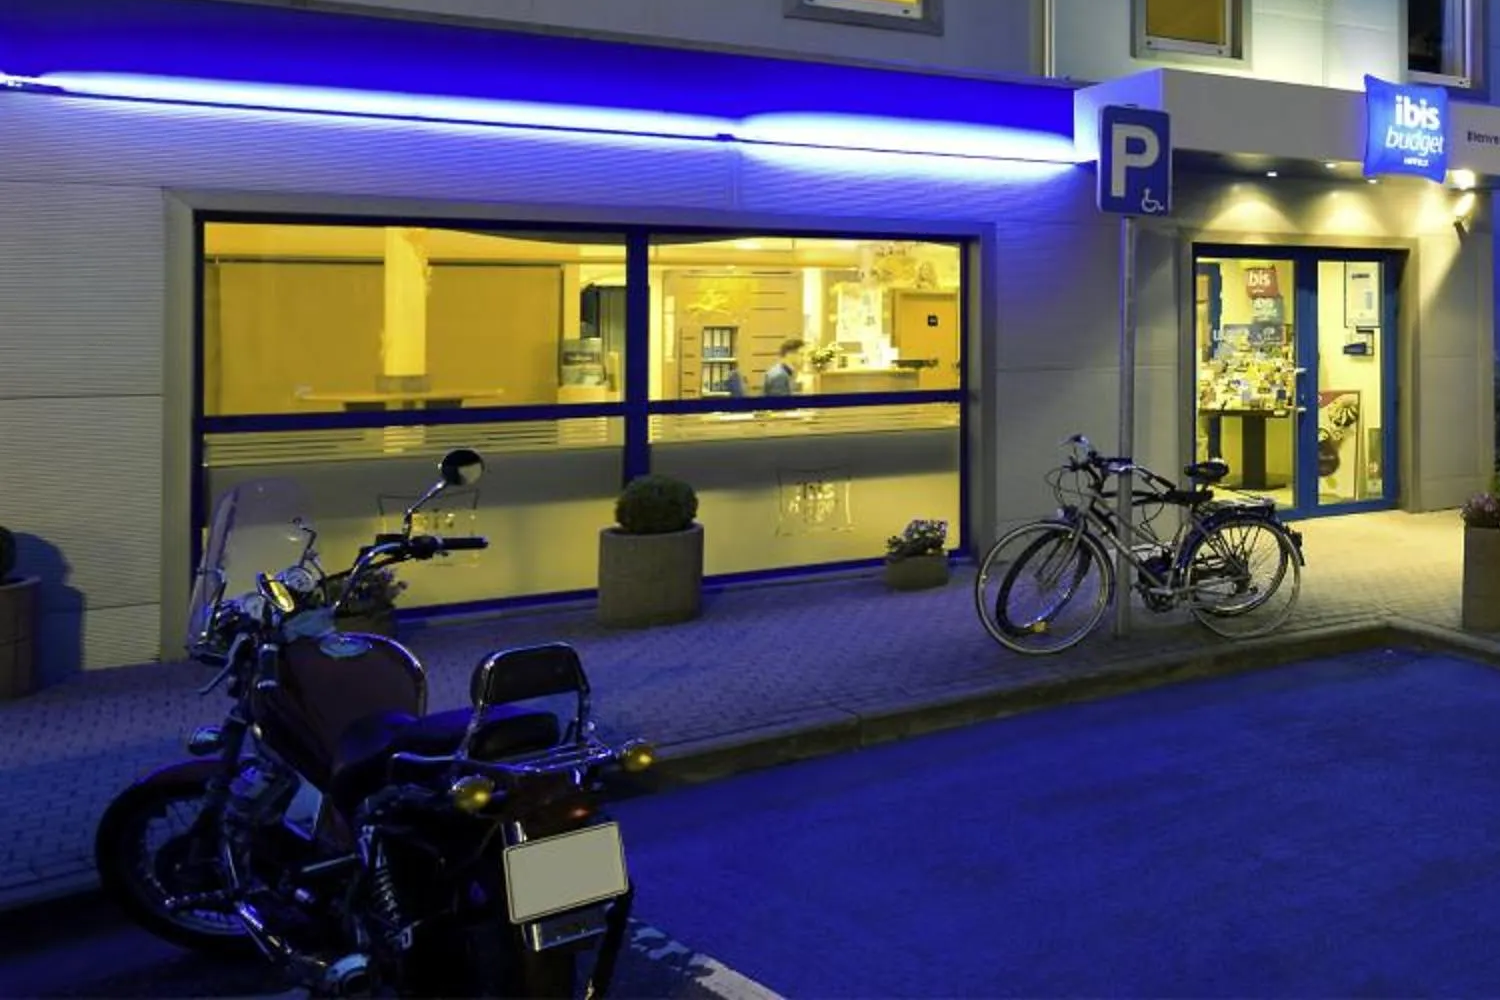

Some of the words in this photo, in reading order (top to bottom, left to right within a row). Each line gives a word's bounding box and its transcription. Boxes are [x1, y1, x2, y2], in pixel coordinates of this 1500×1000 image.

[1394, 95, 1441, 131] ibis
[1111, 122, 1159, 197] P
[1385, 126, 1444, 157] budget
